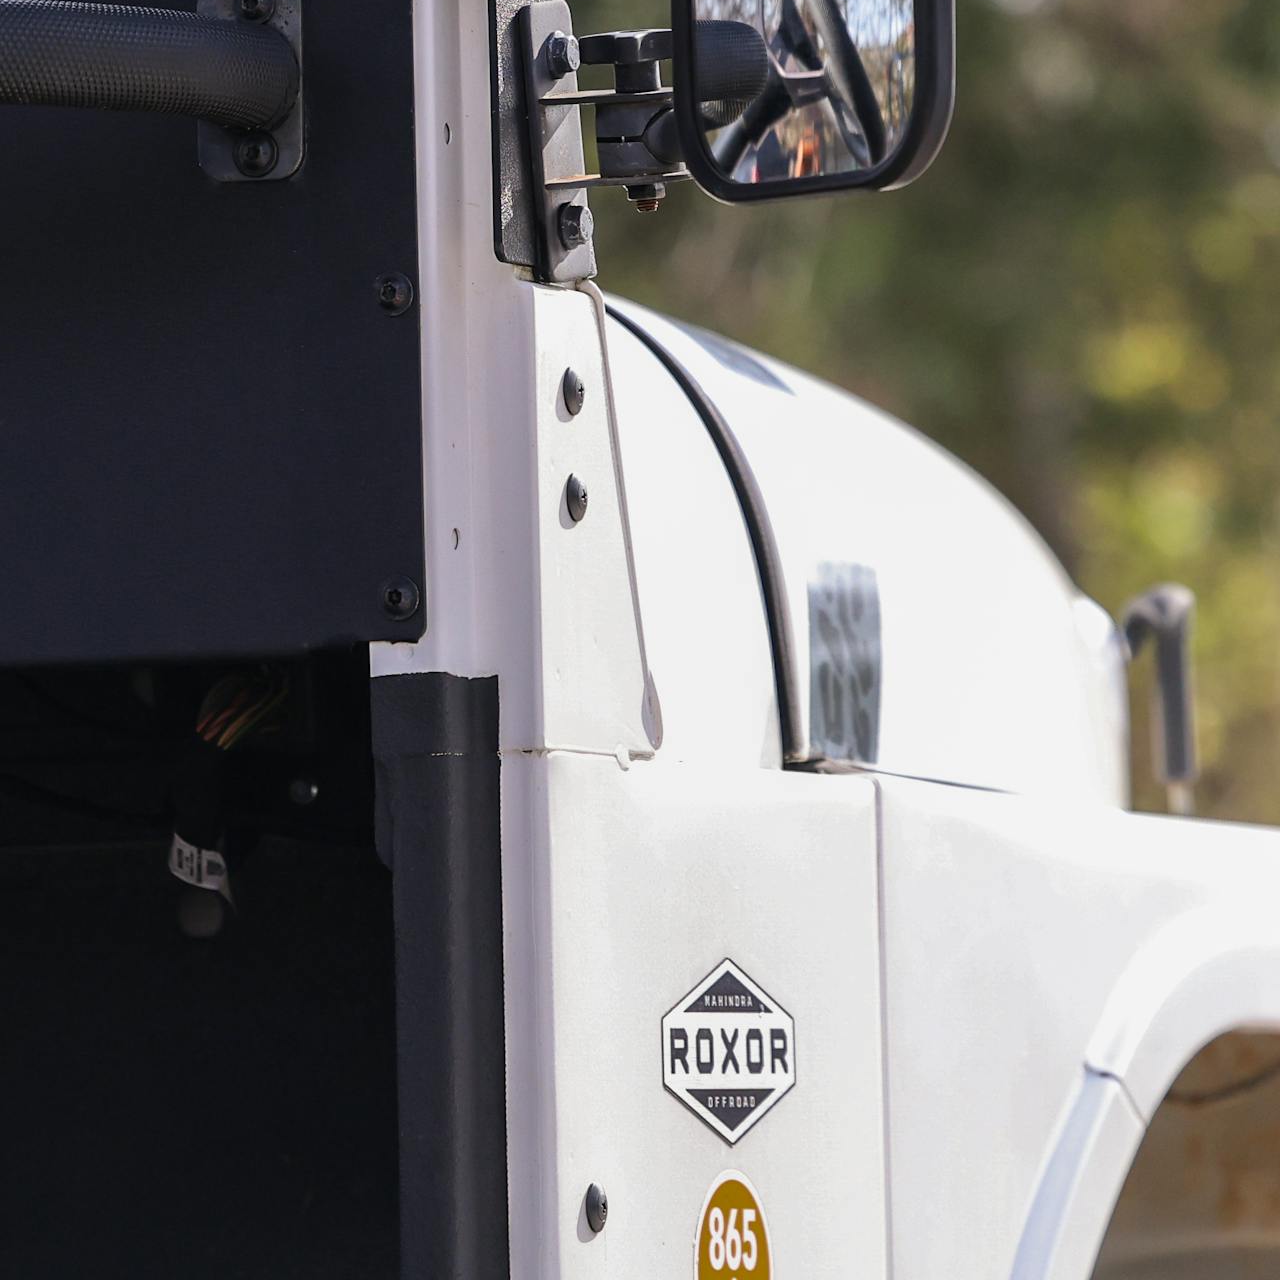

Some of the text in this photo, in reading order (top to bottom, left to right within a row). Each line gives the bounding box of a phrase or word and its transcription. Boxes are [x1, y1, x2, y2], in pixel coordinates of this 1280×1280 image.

[704, 994, 753, 1007] MAHINDRA
[670, 1027, 789, 1074] ROXOR
[707, 1096, 756, 1108] OFFROAD
[709, 1206, 758, 1271] 865
